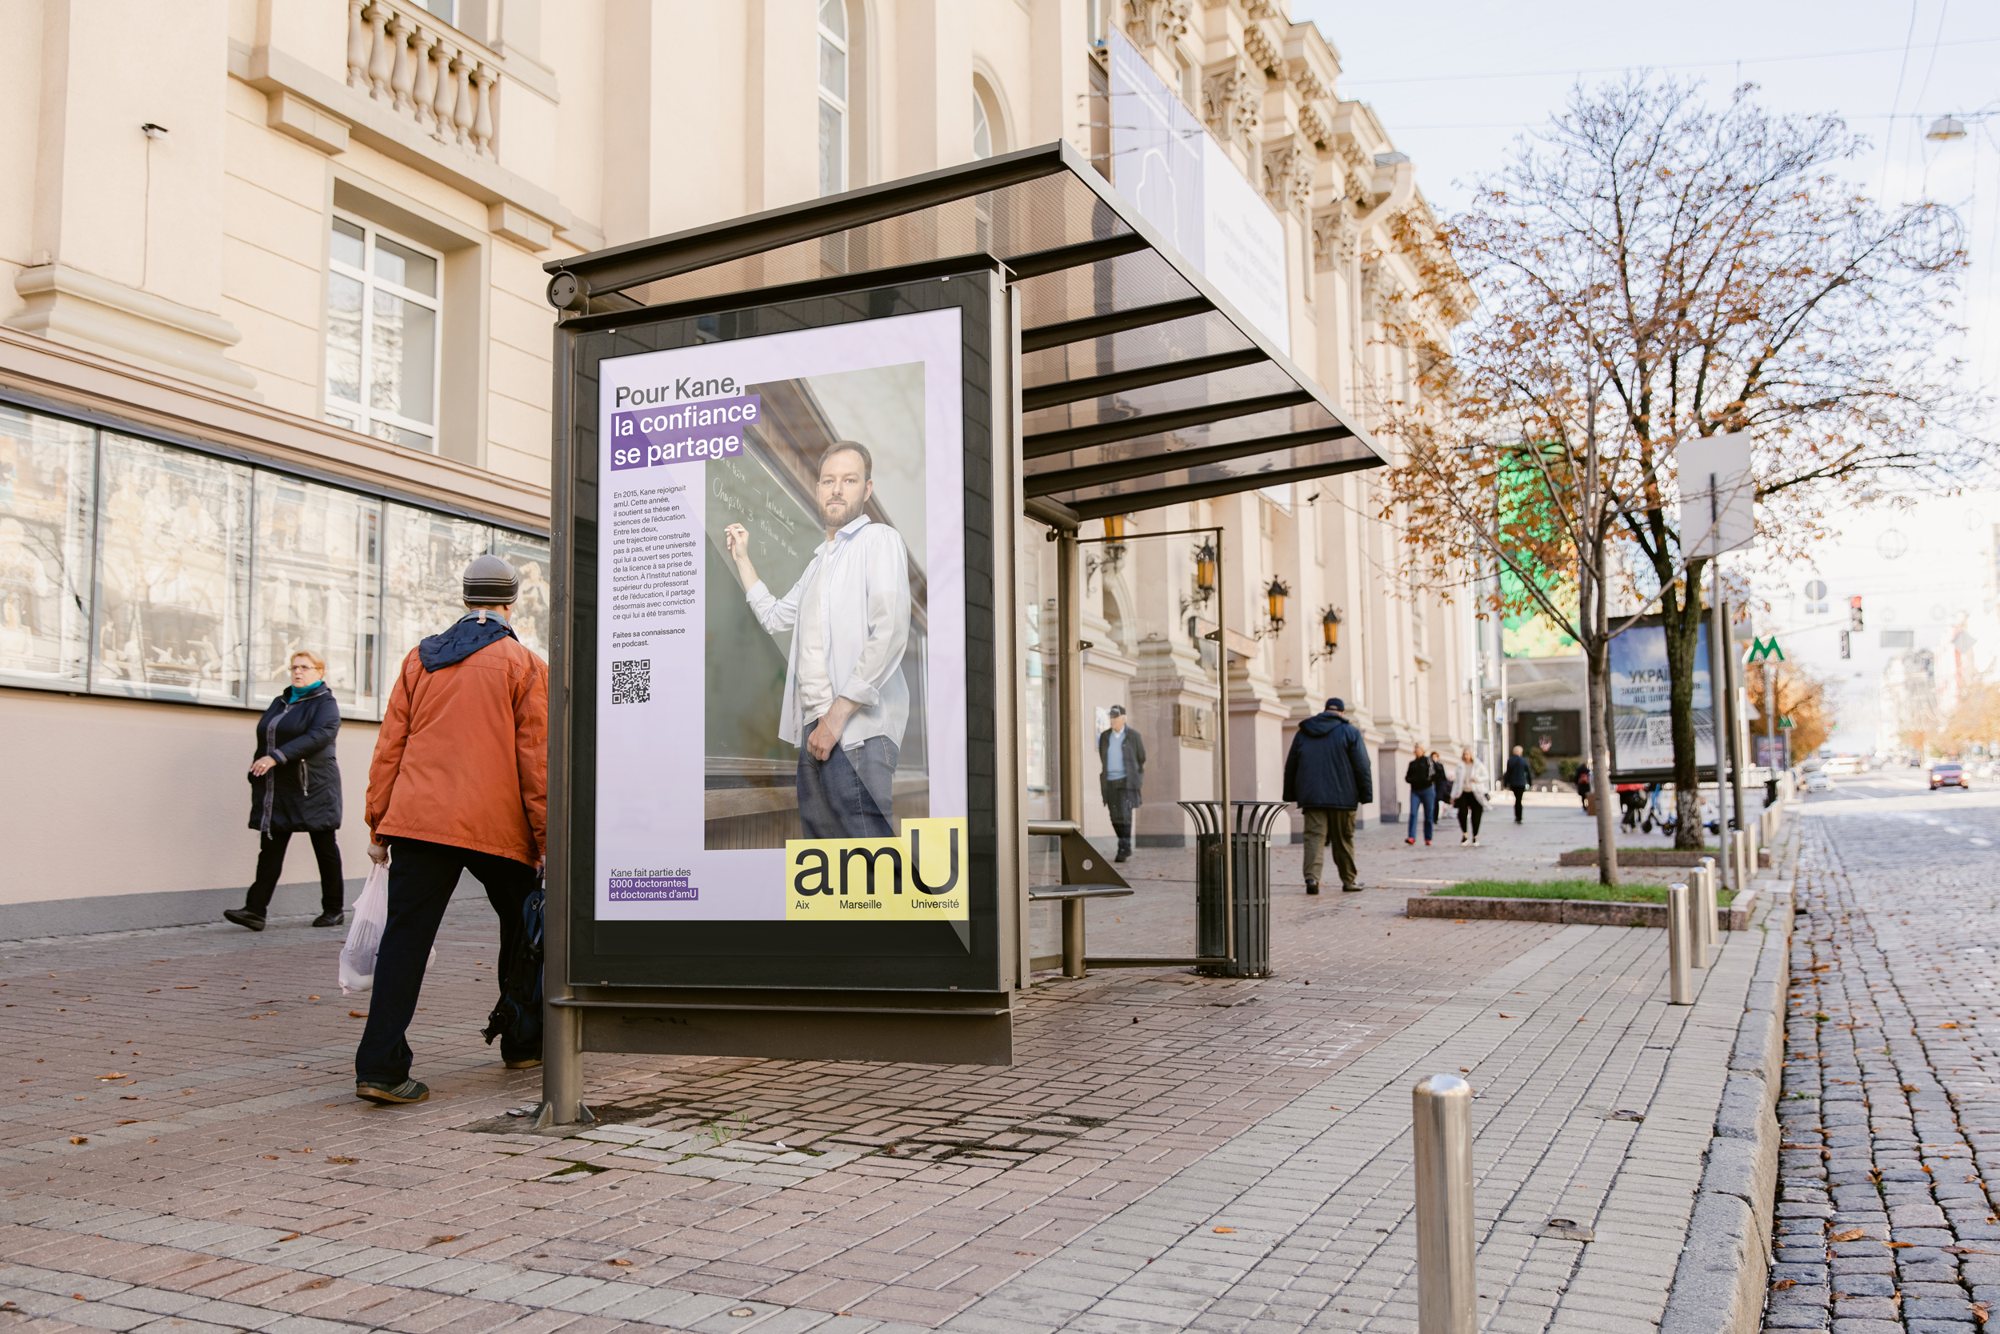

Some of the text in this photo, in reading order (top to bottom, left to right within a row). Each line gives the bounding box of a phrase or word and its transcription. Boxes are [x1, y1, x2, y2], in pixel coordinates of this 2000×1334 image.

[616, 376, 740, 407] Pour Kane,
[615, 403, 756, 437] la confiance
[615, 435, 739, 468] se partage
[657, 485, 686, 495] rejoignait
[627, 535, 657, 544] trajectoire
[659, 532, 690, 540] construite
[666, 540, 696, 549] université
[613, 557, 623, 565] qui
[638, 553, 658, 562] ouvert
[671, 551, 693, 559] portes,
[667, 561, 682, 569] prise
[613, 584, 642, 592] supérieur
[653, 579, 688, 589] professorat
[671, 589, 695, 597] partage
[613, 602, 645, 611] désormais
[663, 598, 695, 606] conviction
[658, 608, 686, 616] transmis.
[641, 627, 685, 637] connaissance
[622, 640, 648, 649] podcast.
[794, 828, 960, 896] amU
[611, 868, 691, 878] Kane fait partie des
[610, 879, 686, 888] 3000 doctorantes
[621, 890, 667, 899] doctorants
[795, 898, 960, 909] Aix Marseille Université
